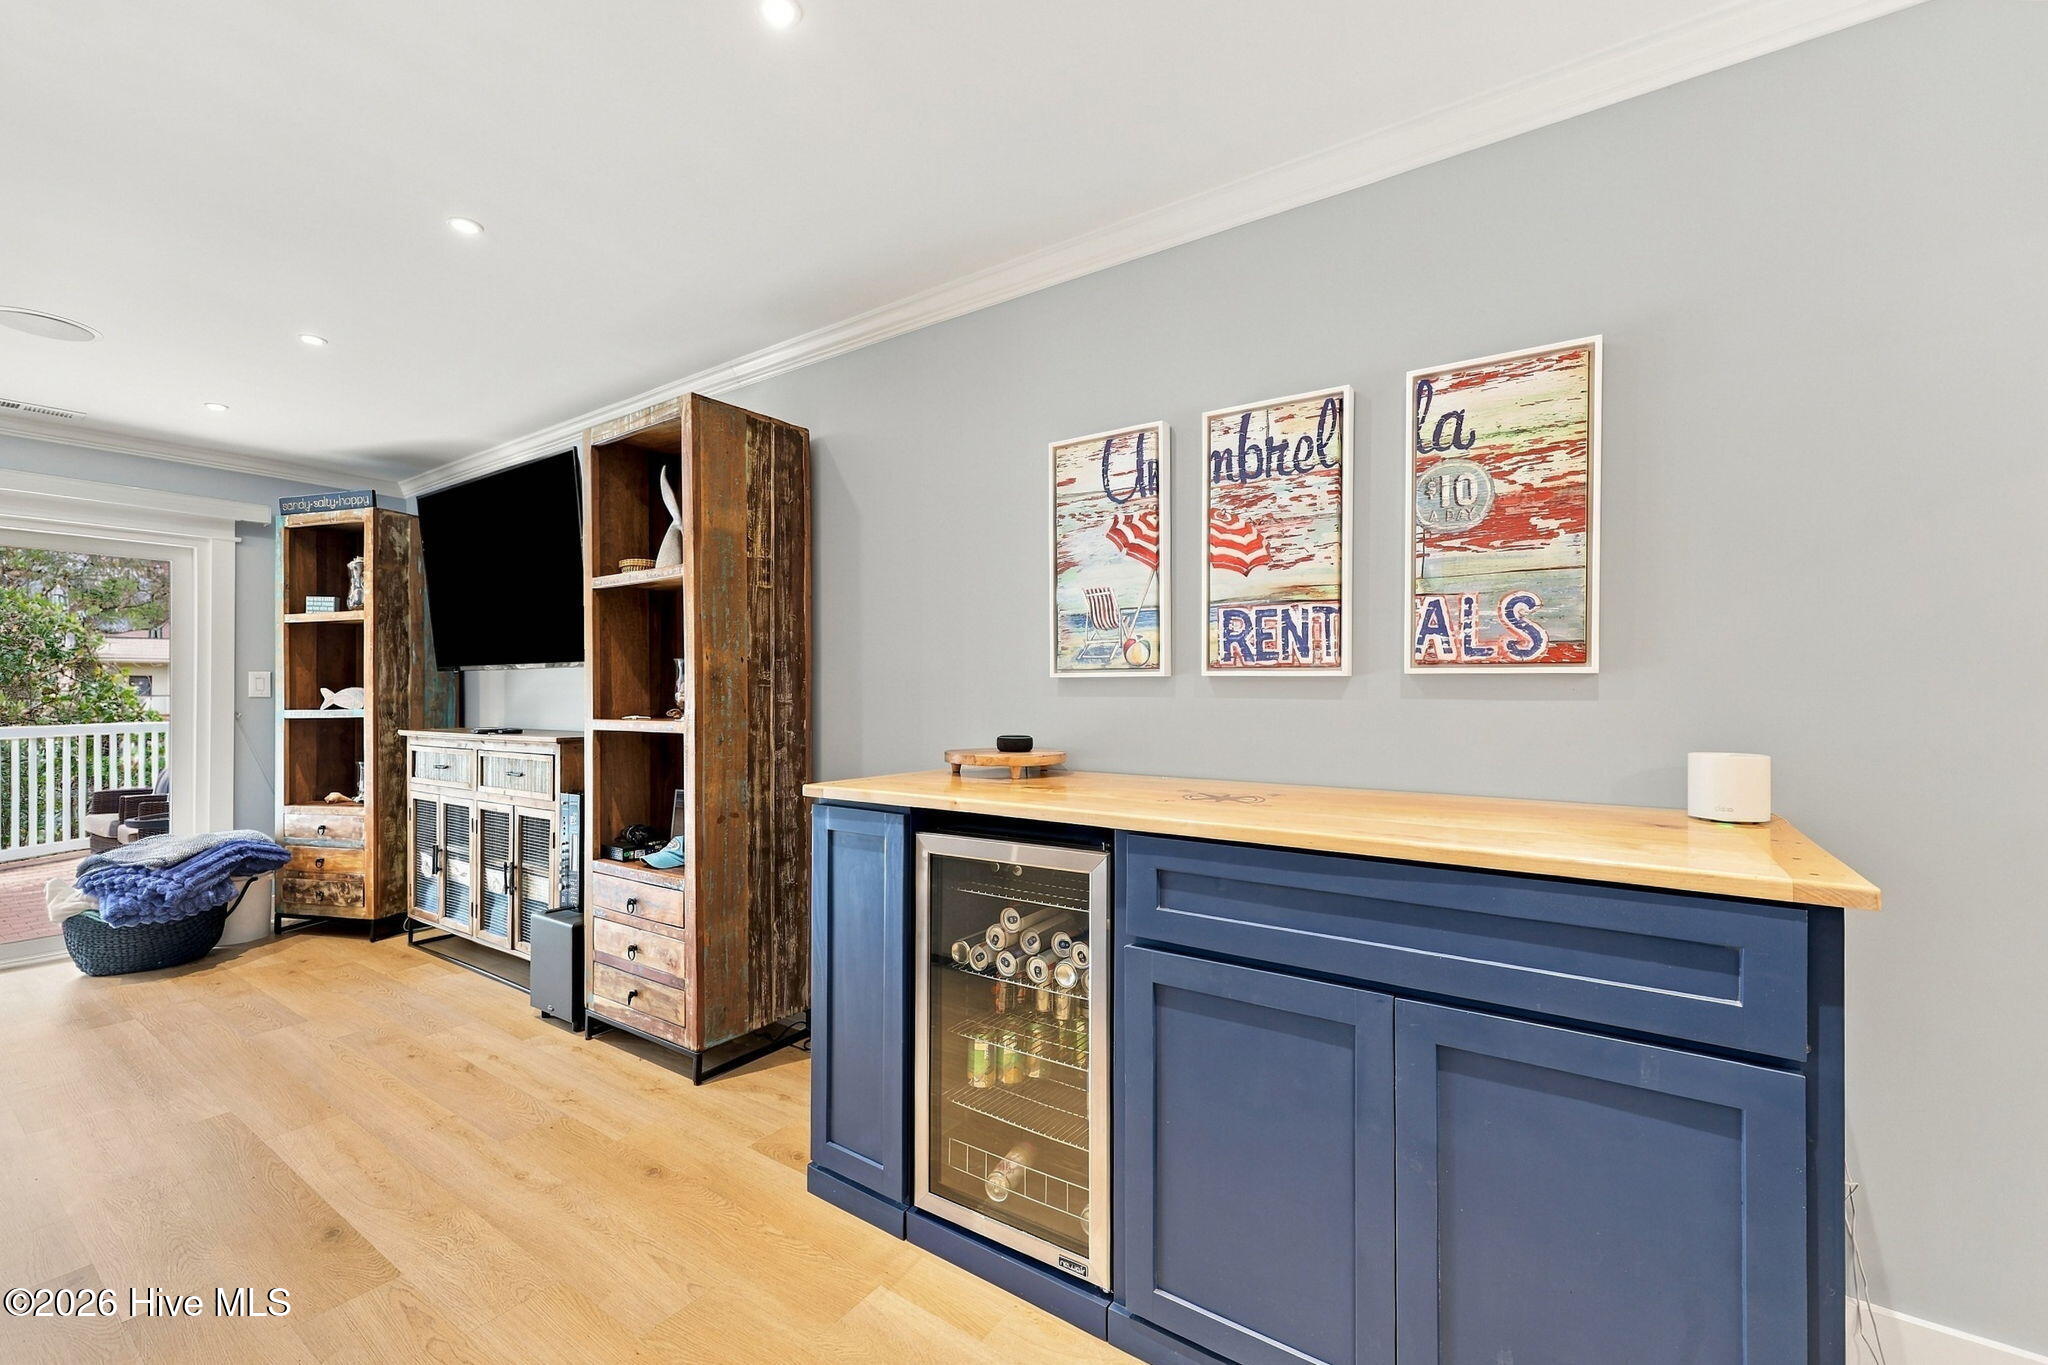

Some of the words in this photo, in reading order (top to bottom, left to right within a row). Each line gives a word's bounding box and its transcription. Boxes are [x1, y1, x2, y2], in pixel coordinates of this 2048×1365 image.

[1424, 474, 1478, 509] $10
[1429, 509, 1439, 522] A
[1445, 506, 1476, 522] DAY
[1221, 604, 1341, 663] RENT
[1415, 594, 1546, 661] ALS
